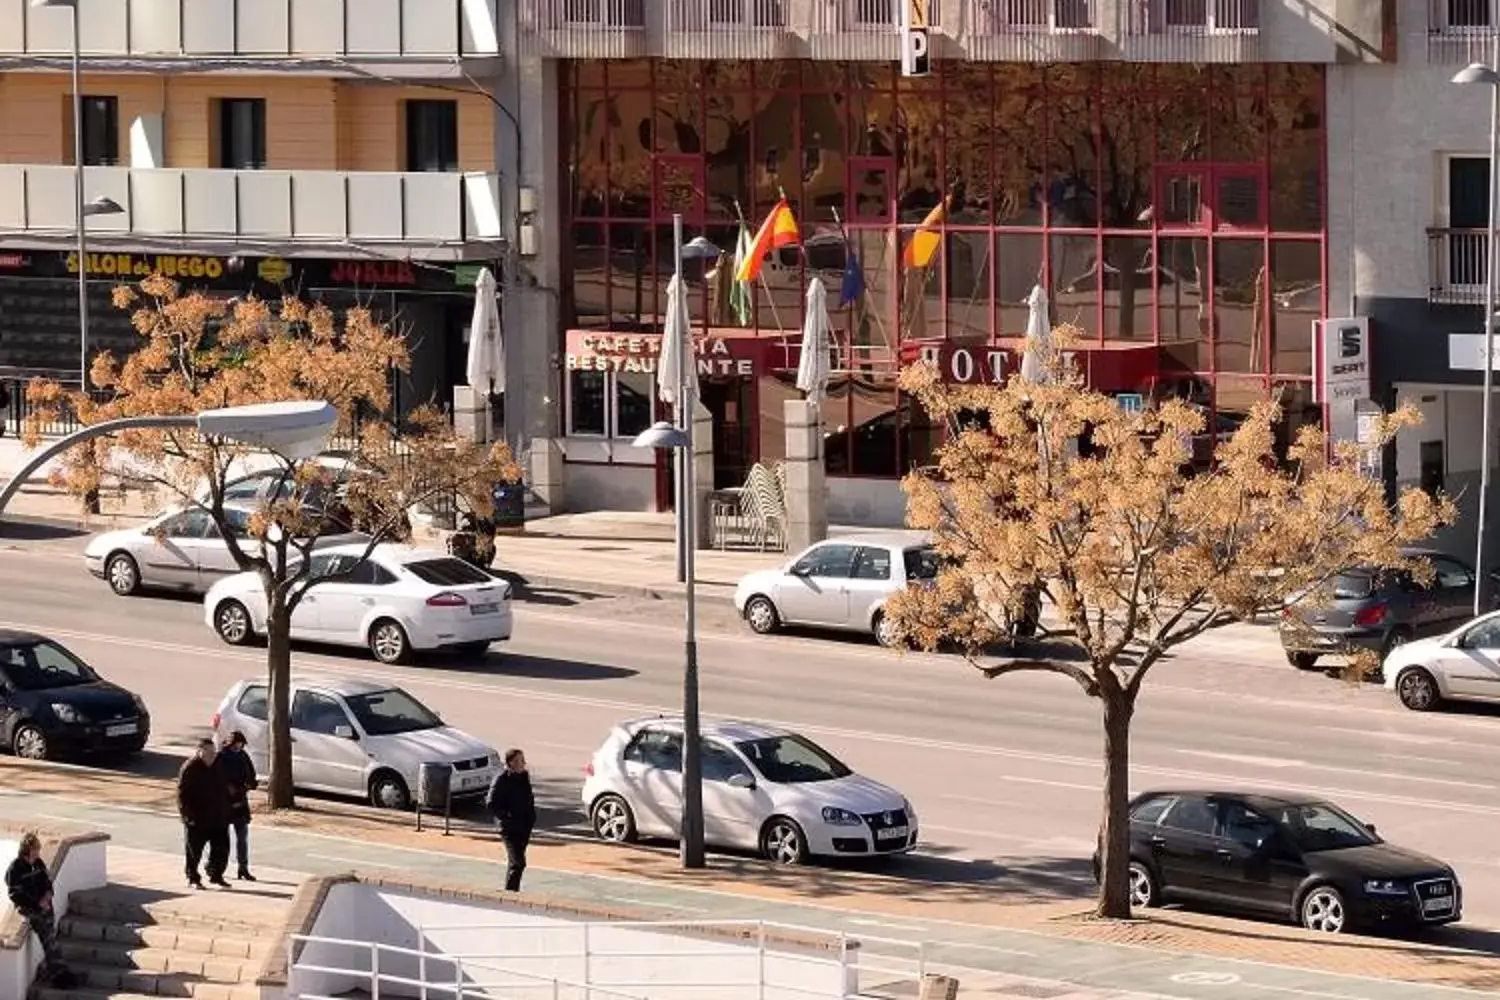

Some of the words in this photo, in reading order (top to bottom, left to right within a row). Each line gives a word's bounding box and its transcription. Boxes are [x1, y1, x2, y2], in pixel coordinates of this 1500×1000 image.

[909, 30, 928, 74] P
[155, 256, 223, 278] JUEGO
[583, 335, 729, 355] CAFETIA
[567, 353, 753, 375] RESTAUNTE
[919, 346, 1085, 386] OTL
